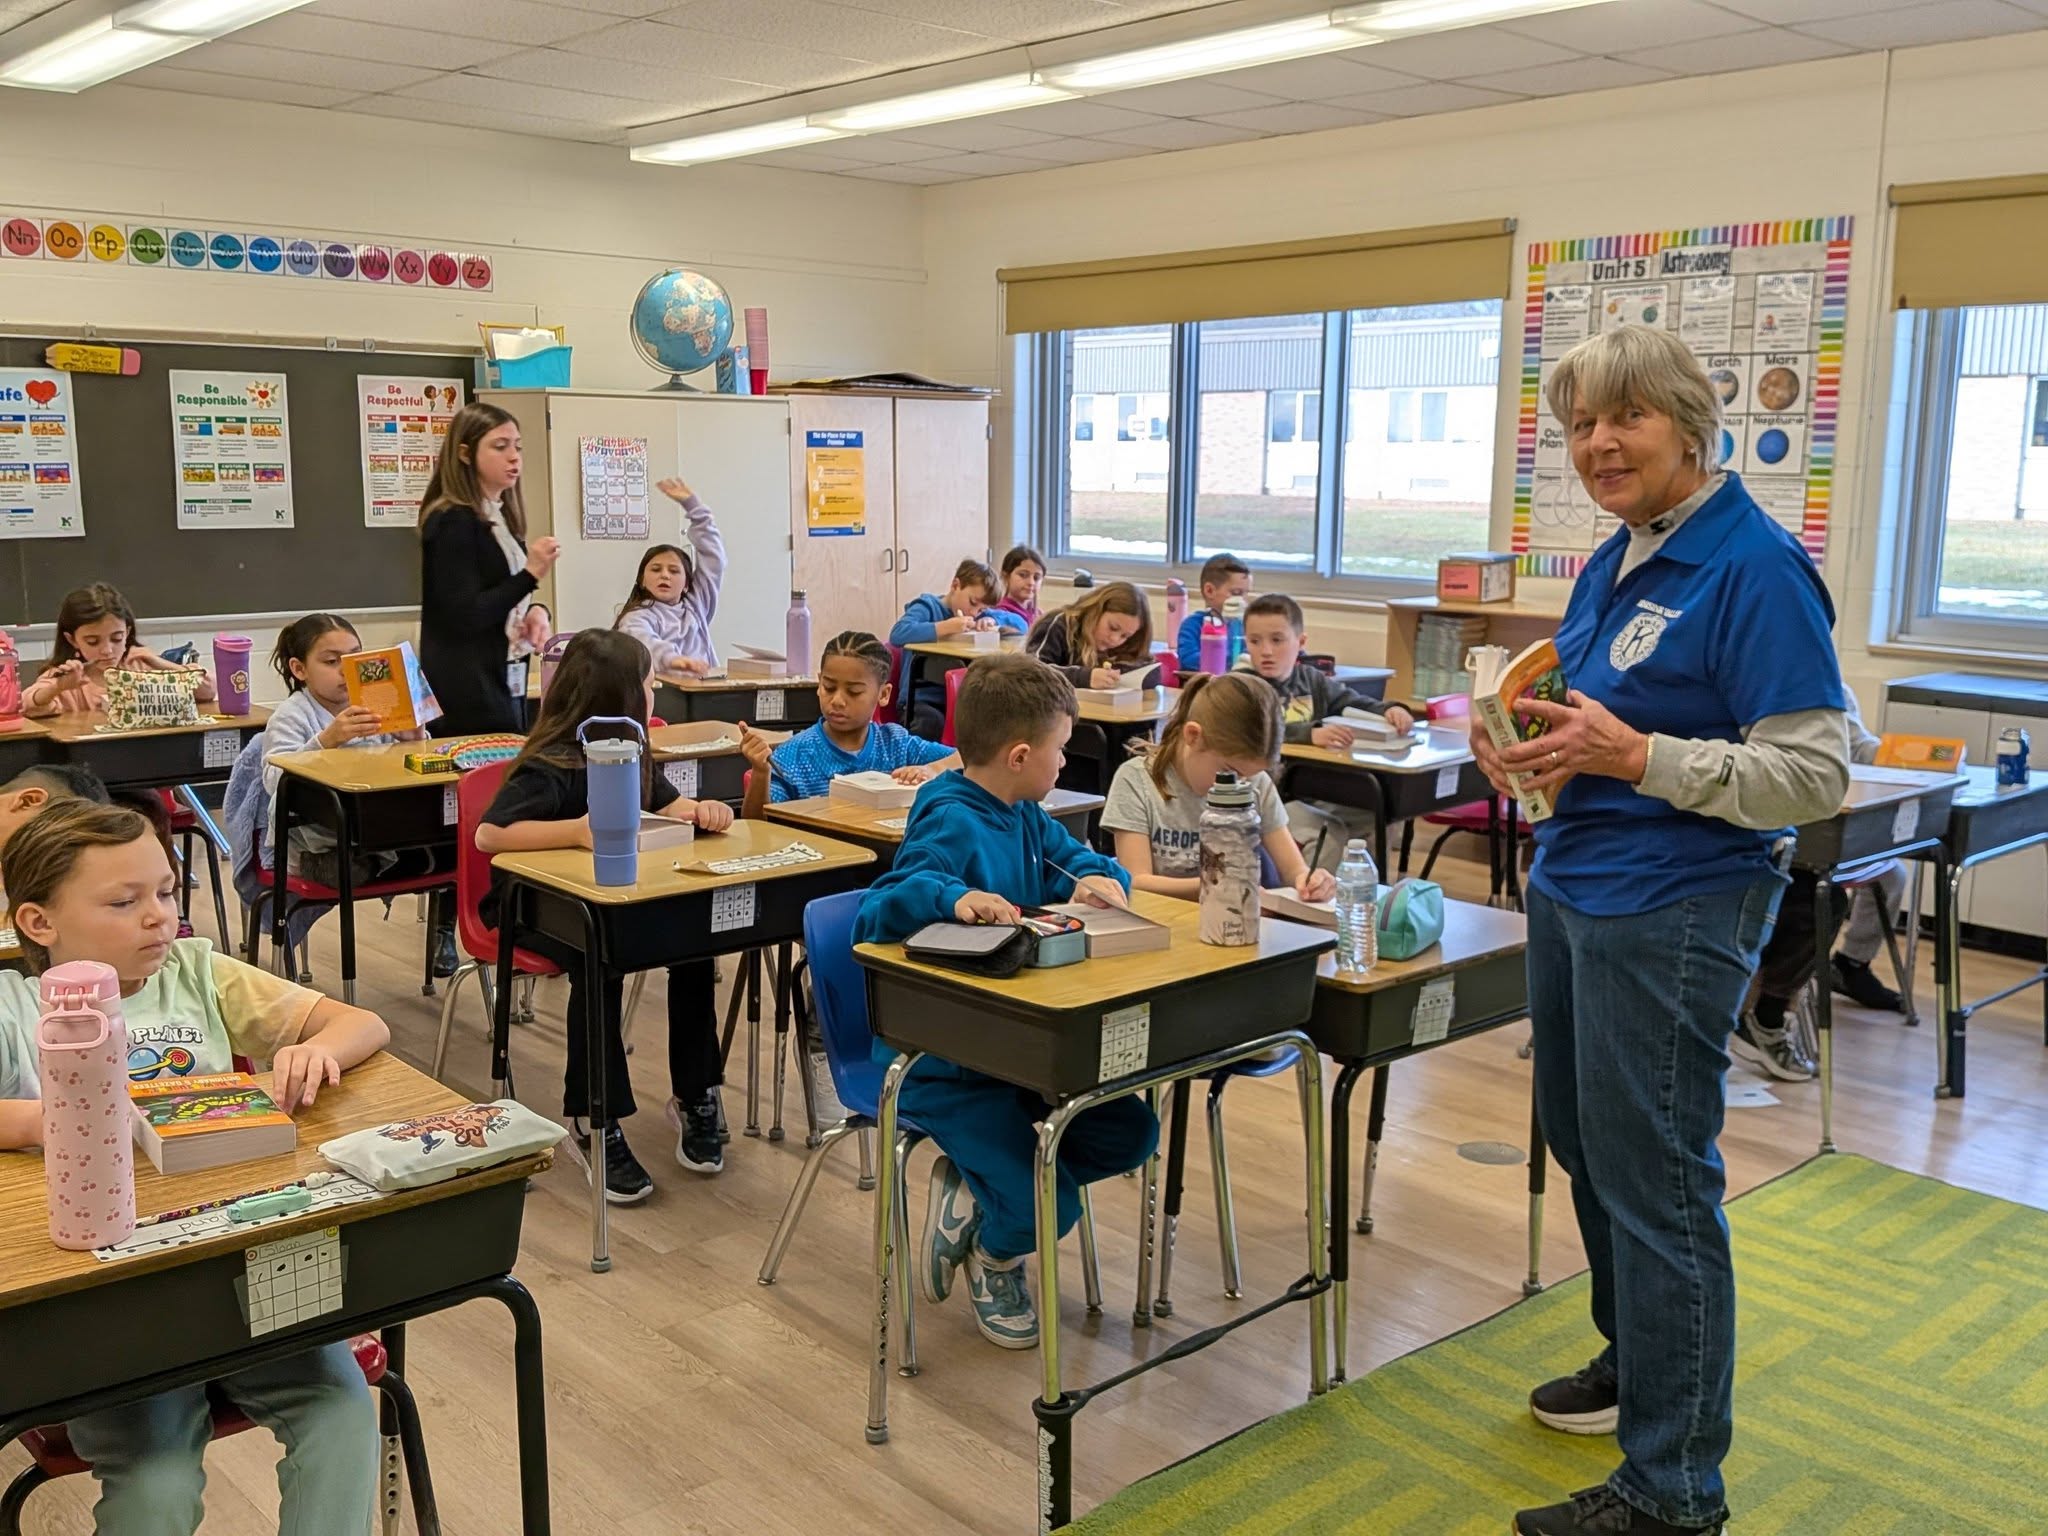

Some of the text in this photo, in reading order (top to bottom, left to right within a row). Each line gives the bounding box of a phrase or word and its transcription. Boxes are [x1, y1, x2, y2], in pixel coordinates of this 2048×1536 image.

[7, 225, 34, 246] Nn
[51, 228, 78, 249] Oo
[94, 231, 118, 256] Pp
[361, 252, 391, 272] Ww
[399, 255, 419, 274] Xx
[433, 260, 451, 280] Yy
[466, 262, 486, 280] Zz
[1592, 259, 1646, 280] Unit 5
[1707, 355, 1742, 368] Earth
[1765, 354, 1798, 365] Mars
[0, 388, 23, 401] afe
[204, 384, 219, 394] Be
[388, 385, 402, 394] Be
[177, 394, 248, 407] Responsible
[367, 395, 423, 407] Respectful
[1539, 437, 1564, 449] Plan
[138, 684, 154, 694] JUST
[138, 694, 180, 704] WHO LOVES
[1153, 827, 1200, 848] AEROP
[1185, 851, 1200, 860] YO
[132, 1025, 204, 1044] PLANET
[132, 1079, 184, 1090] GAZETTEER
[190, 1075, 242, 1085] DICTIONARY
[178, 1183, 370, 1233] Sloa land
[264, 1241, 301, 1257] Sloan
